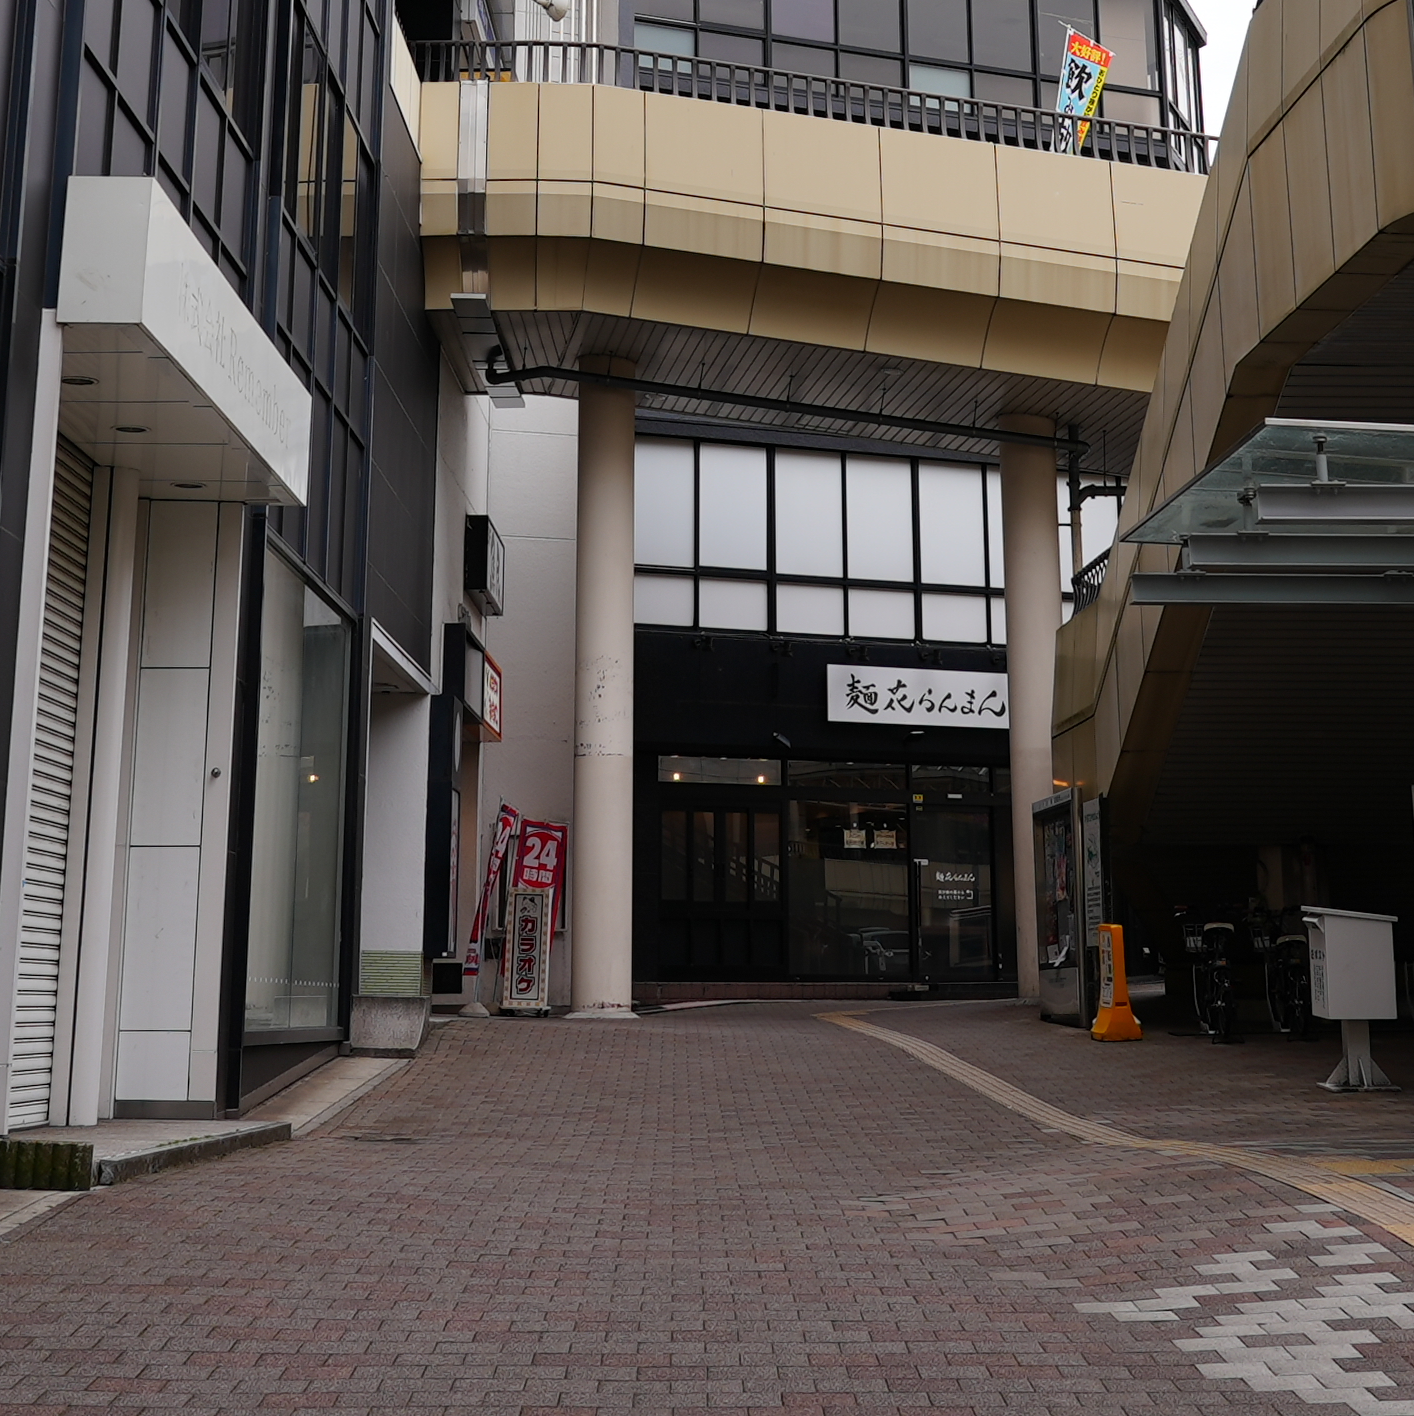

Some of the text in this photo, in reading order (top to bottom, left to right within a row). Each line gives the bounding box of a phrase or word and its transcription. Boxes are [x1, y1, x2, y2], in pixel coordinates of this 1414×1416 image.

[523, 835, 558, 870] 24
[516, 914, 538, 994] カラオケ
